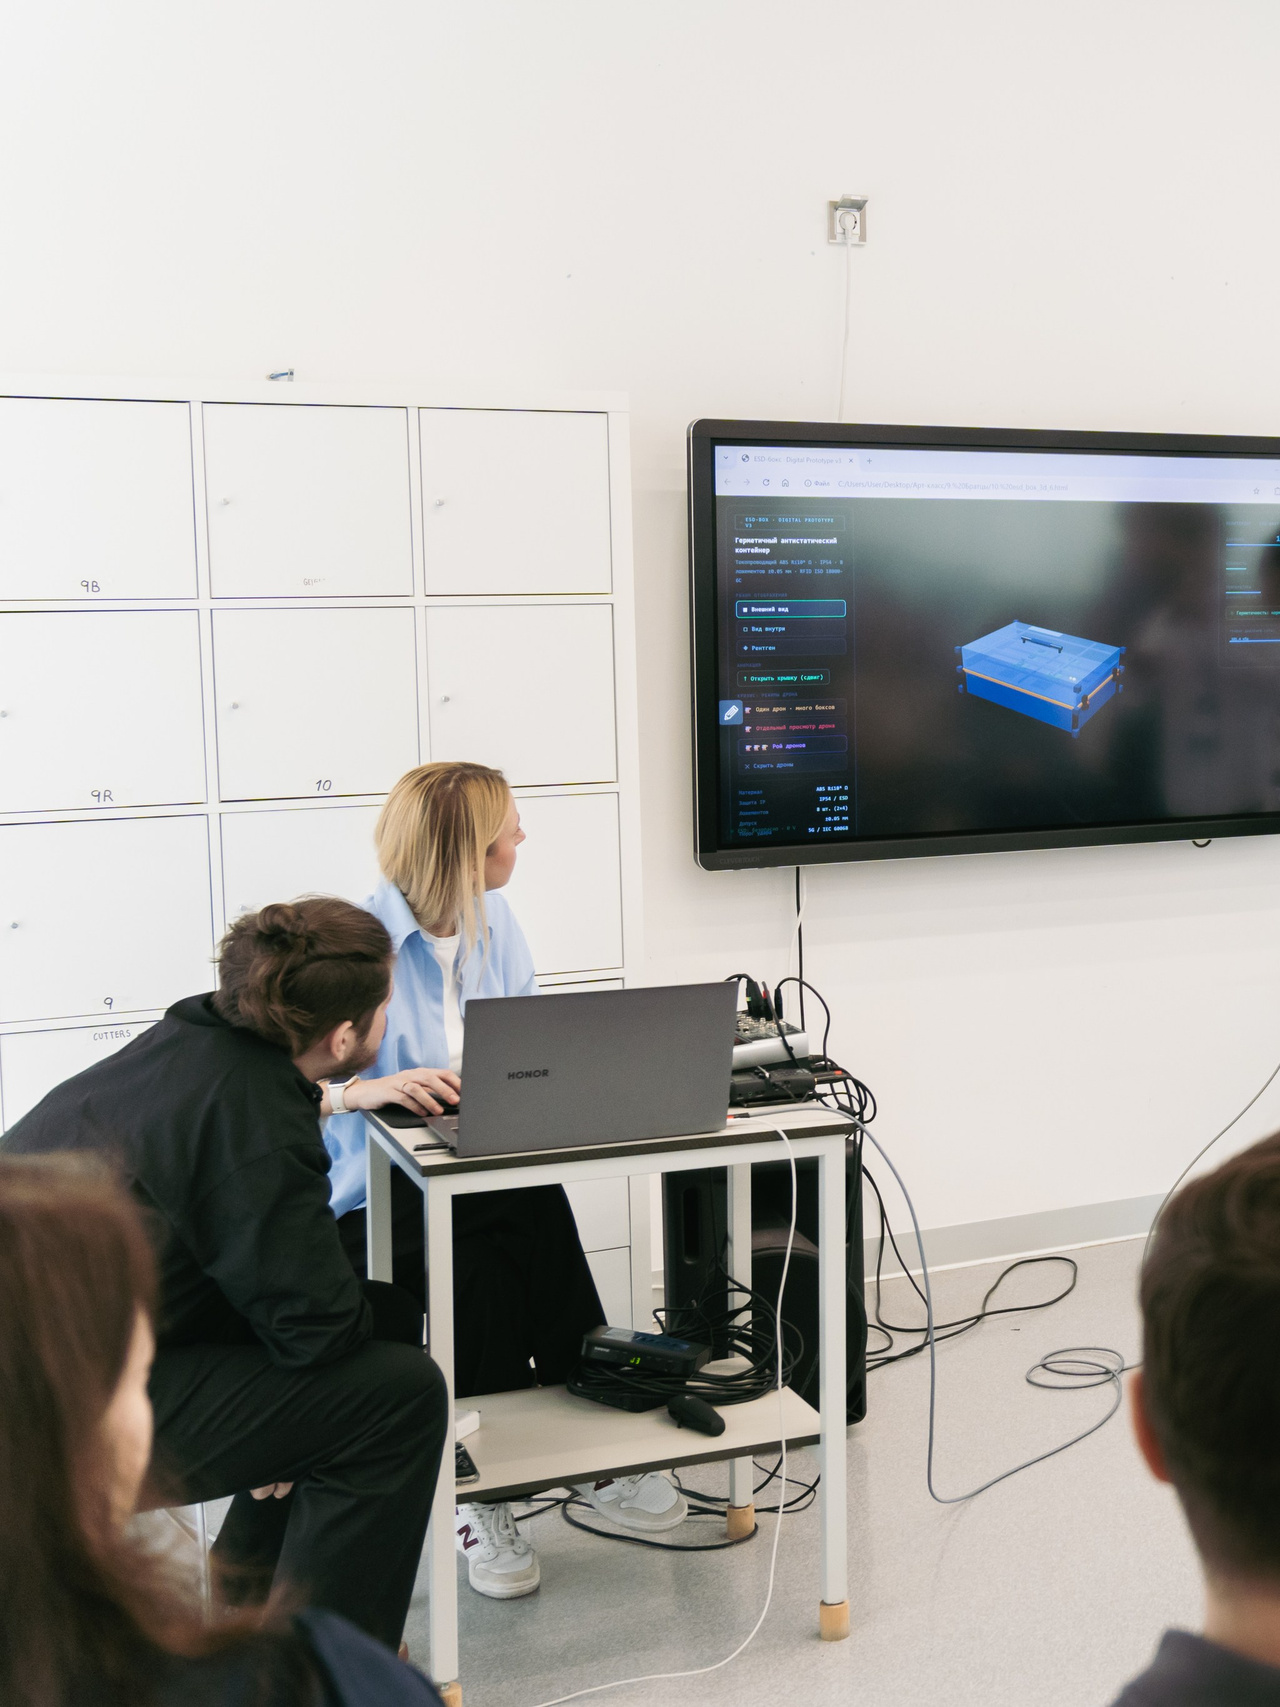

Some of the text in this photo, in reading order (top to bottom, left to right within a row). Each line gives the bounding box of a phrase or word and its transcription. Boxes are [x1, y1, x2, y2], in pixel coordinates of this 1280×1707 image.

[735, 537, 778, 545] Герметичный
[735, 547, 770, 555] контейнер
[80, 579, 101, 593] 9B
[315, 779, 332, 792] 10
[90, 789, 114, 803] 9R
[103, 996, 114, 1010] 9
[93, 1029, 132, 1041] CUTTERS
[507, 1069, 550, 1080] HONOR
